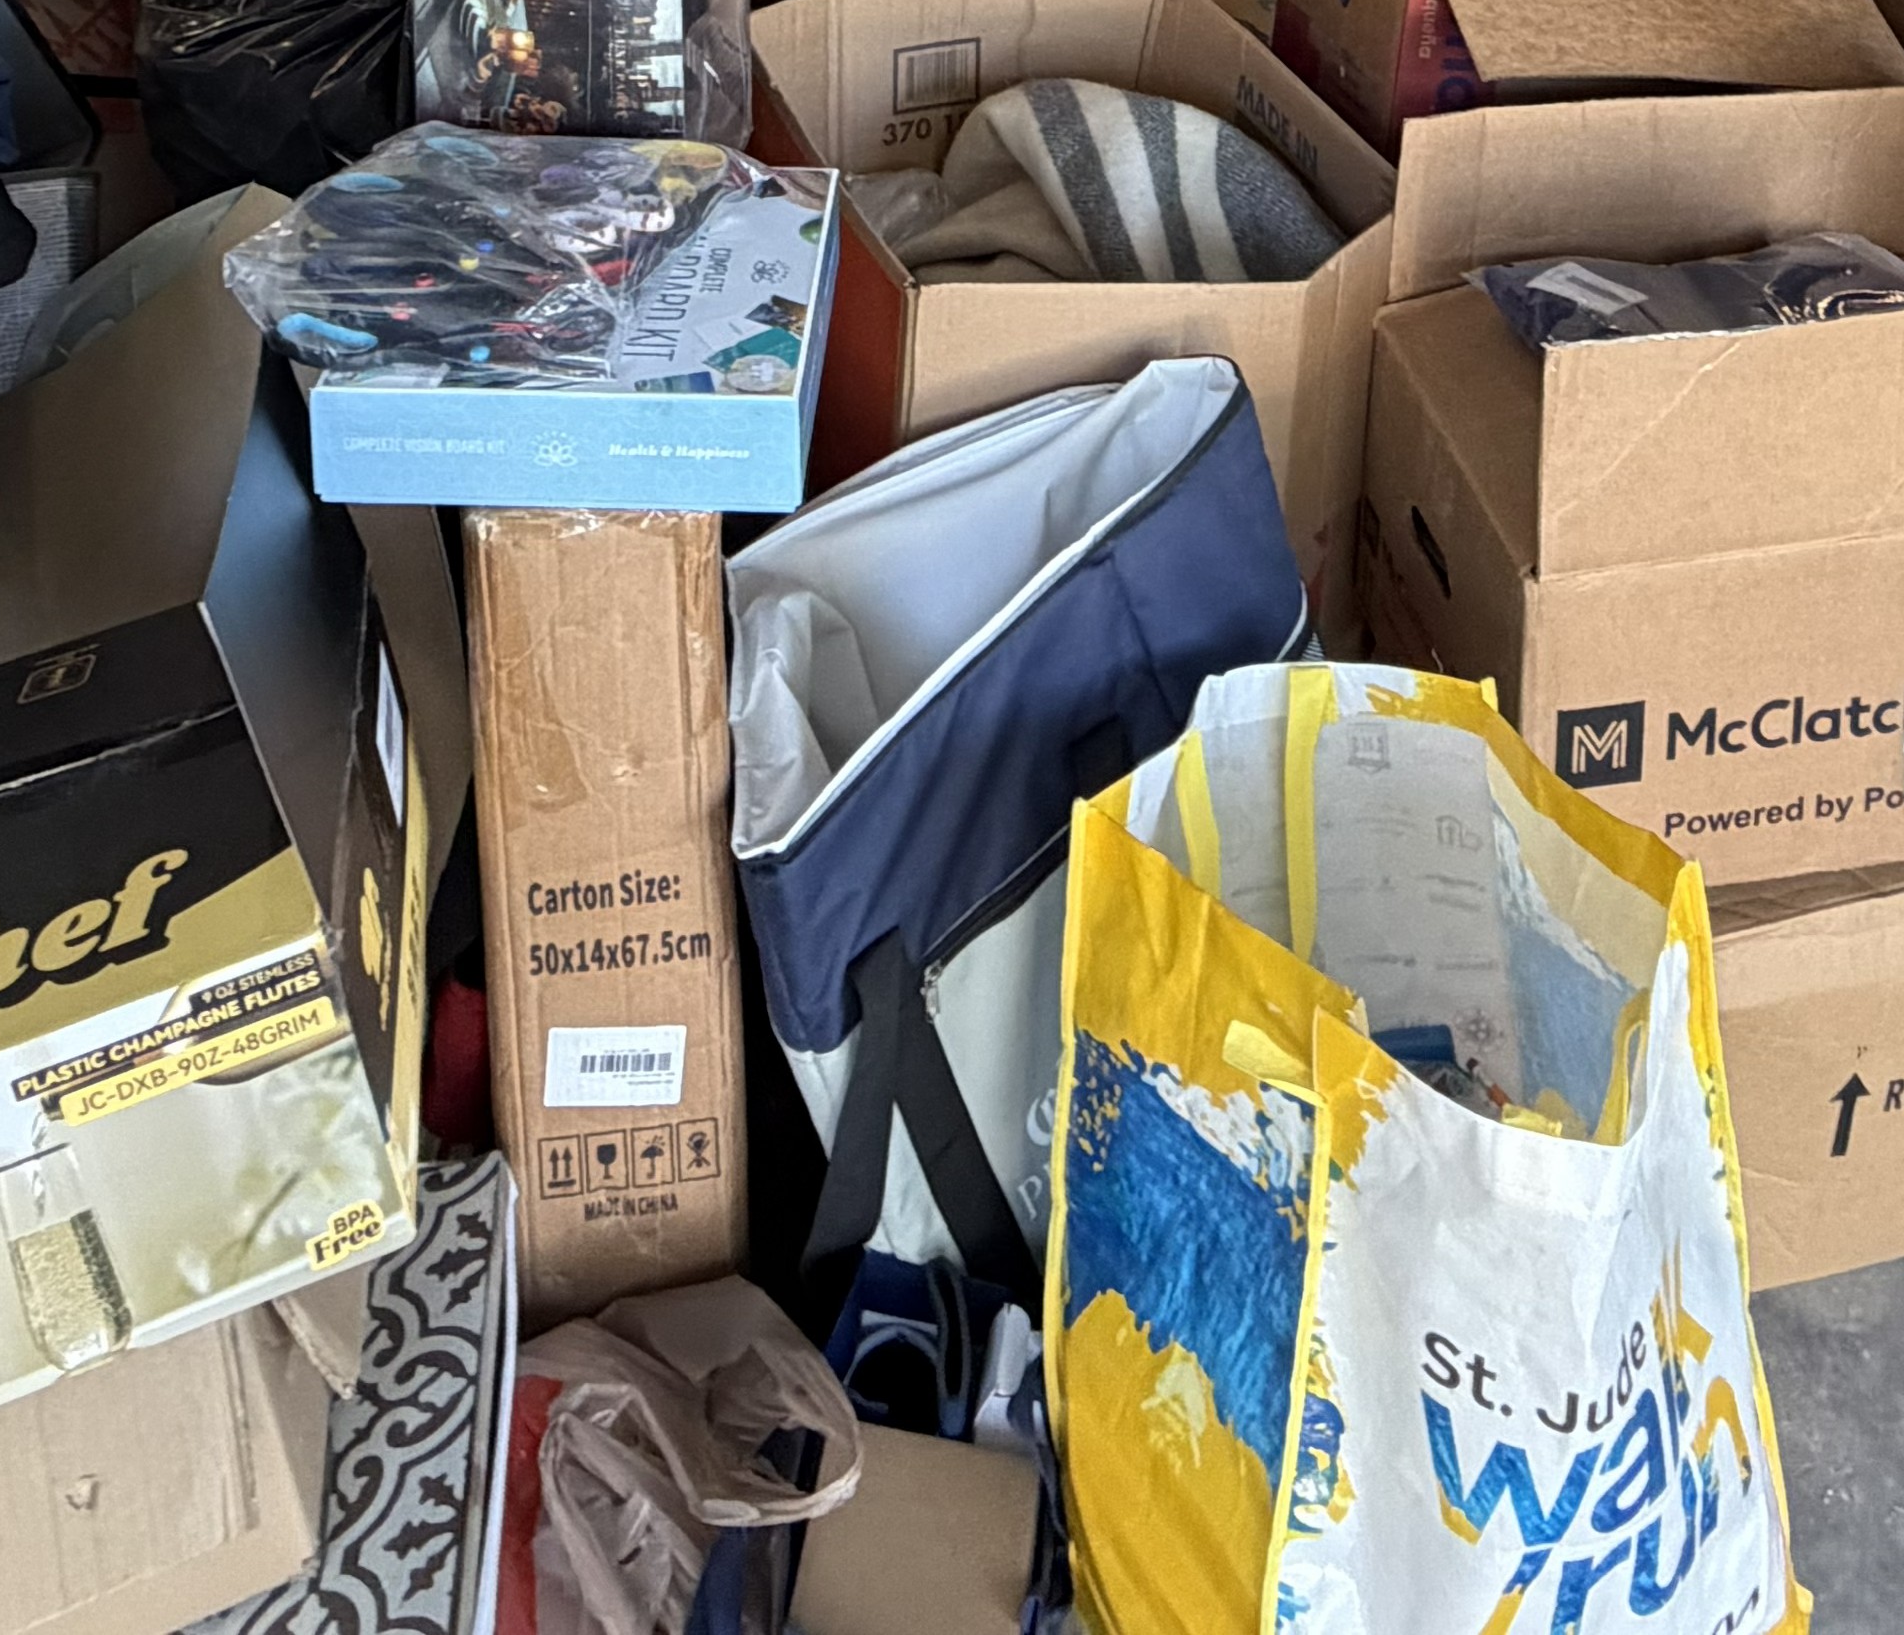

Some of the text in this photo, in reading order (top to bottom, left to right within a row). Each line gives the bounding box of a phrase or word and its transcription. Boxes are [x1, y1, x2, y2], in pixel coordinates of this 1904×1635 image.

[883, 116, 933, 147] 370
[1236, 74, 1318, 173] MADE IN
[621, 328, 681, 363] KIT
[608, 443, 659, 458] Health
[674, 444, 752, 461] Happiness
[1663, 796, 1805, 838] Powered
[1815, 793, 1854, 823] by
[527, 868, 683, 916] Carton Size:
[528, 929, 713, 977] 50x14x67.5cm
[201, 952, 316, 1005] 9 OZ STEMLESS
[16, 969, 322, 1098] PLASTIC CHAMPAGNE FLUTES
[332, 1203, 377, 1236] BPA
[583, 1197, 623, 1222] MADE
[312, 1218, 382, 1265] Free
[1421, 1320, 1647, 1435] St. Jude
